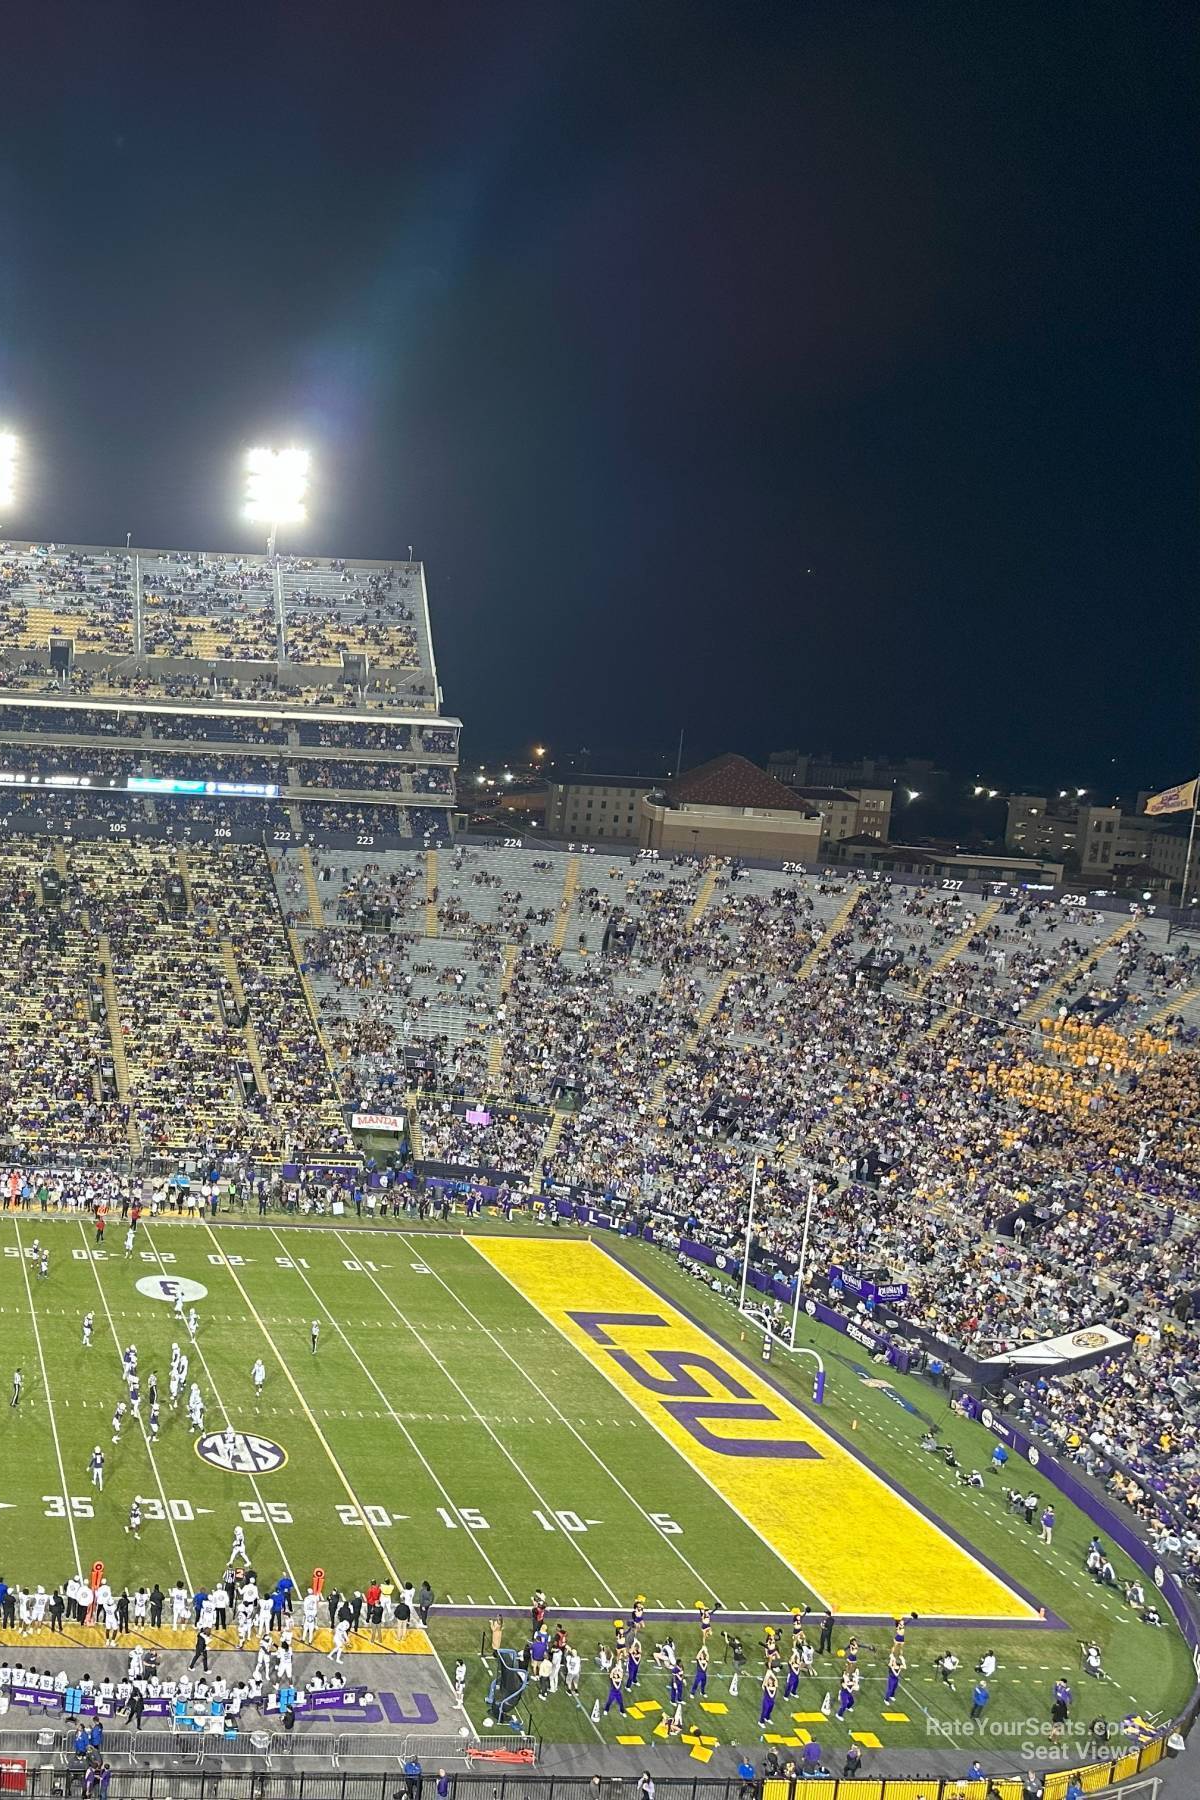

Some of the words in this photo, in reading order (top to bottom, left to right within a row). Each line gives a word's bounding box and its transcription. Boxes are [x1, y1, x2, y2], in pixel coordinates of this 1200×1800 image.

[109, 823, 127, 832] 105
[214, 828, 232, 837] 106
[273, 831, 291, 841] 222
[356, 836, 374, 845] 223
[504, 838, 522, 848] 224
[942, 879, 964, 890] 227
[357, 1114, 400, 1129] MANDA
[71, 1249, 109, 1261] 30
[140, 1251, 178, 1263] 25
[207, 1254, 245, 1266] 20
[275, 1256, 311, 1269] 15
[343, 1259, 379, 1272] 10
[410, 1263, 433, 1275] 5
[564, 1311, 825, 1460] LSU
[41, 1495, 95, 1518] 35
[140, 1498, 195, 1521] 30
[237, 1501, 293, 1524] 25
[334, 1504, 391, 1527] 20
[436, 1507, 491, 1529] 15
[532, 1510, 589, 1532] 10
[649, 1513, 684, 1534] 5
[237, 1570, 244, 1578] 2
